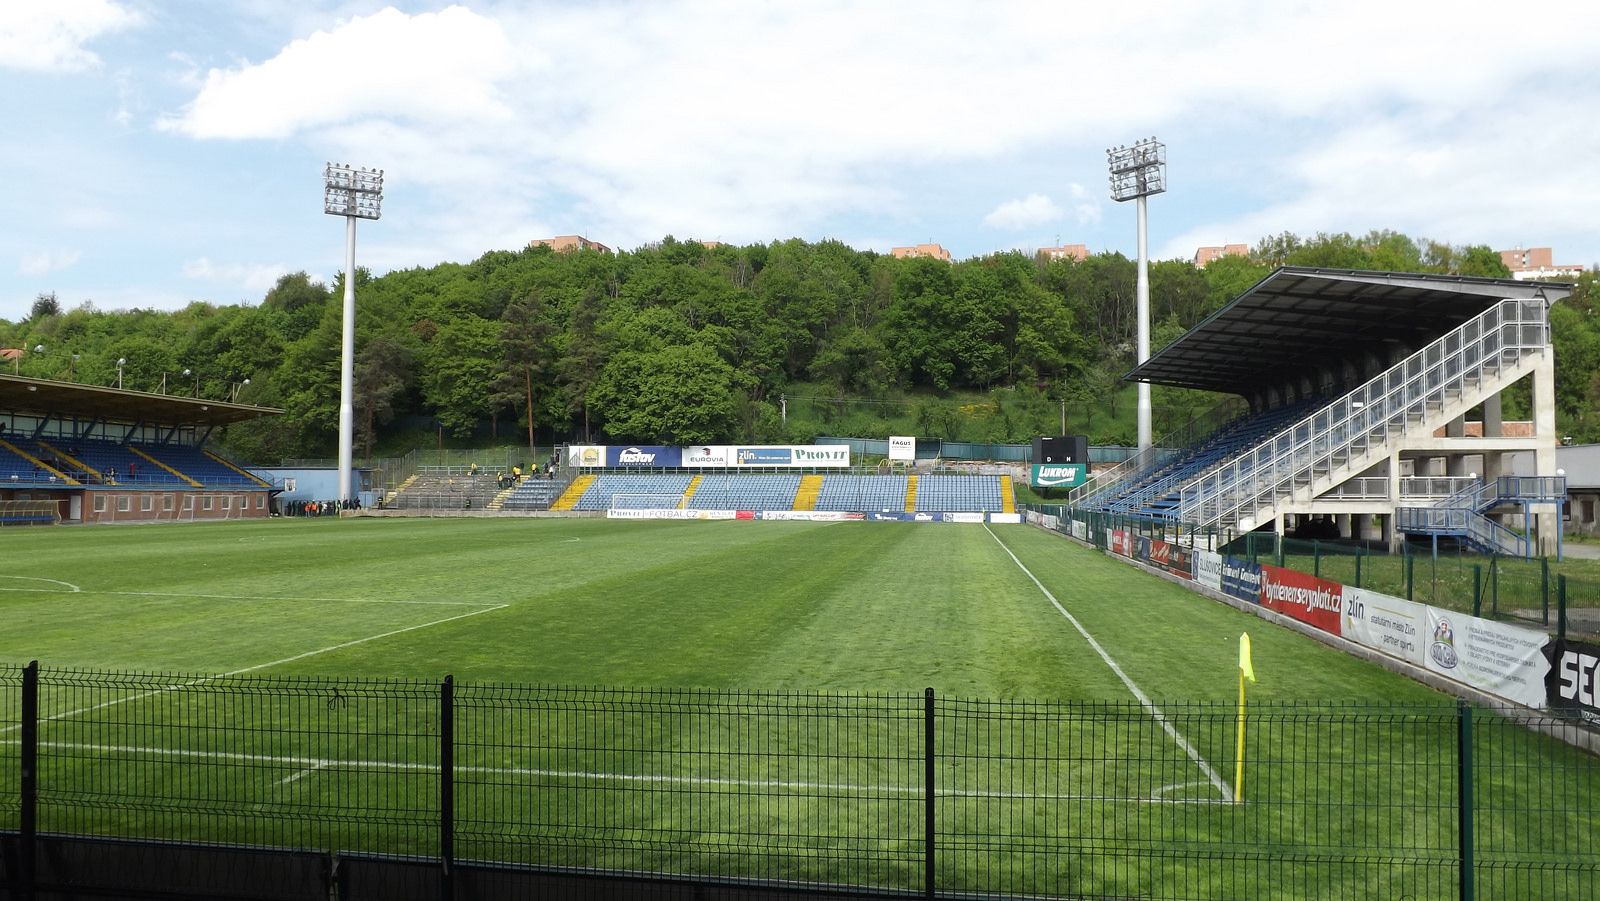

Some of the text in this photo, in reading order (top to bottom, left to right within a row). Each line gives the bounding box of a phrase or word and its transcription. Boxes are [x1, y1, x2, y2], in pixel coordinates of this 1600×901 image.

[619, 448, 656, 463] fastav
[795, 449, 848, 460] PROVIT
[1039, 465, 1076, 478] LUKROM
[1404, 623, 1416, 636] Zlín
[1559, 650, 1600, 708] SE
